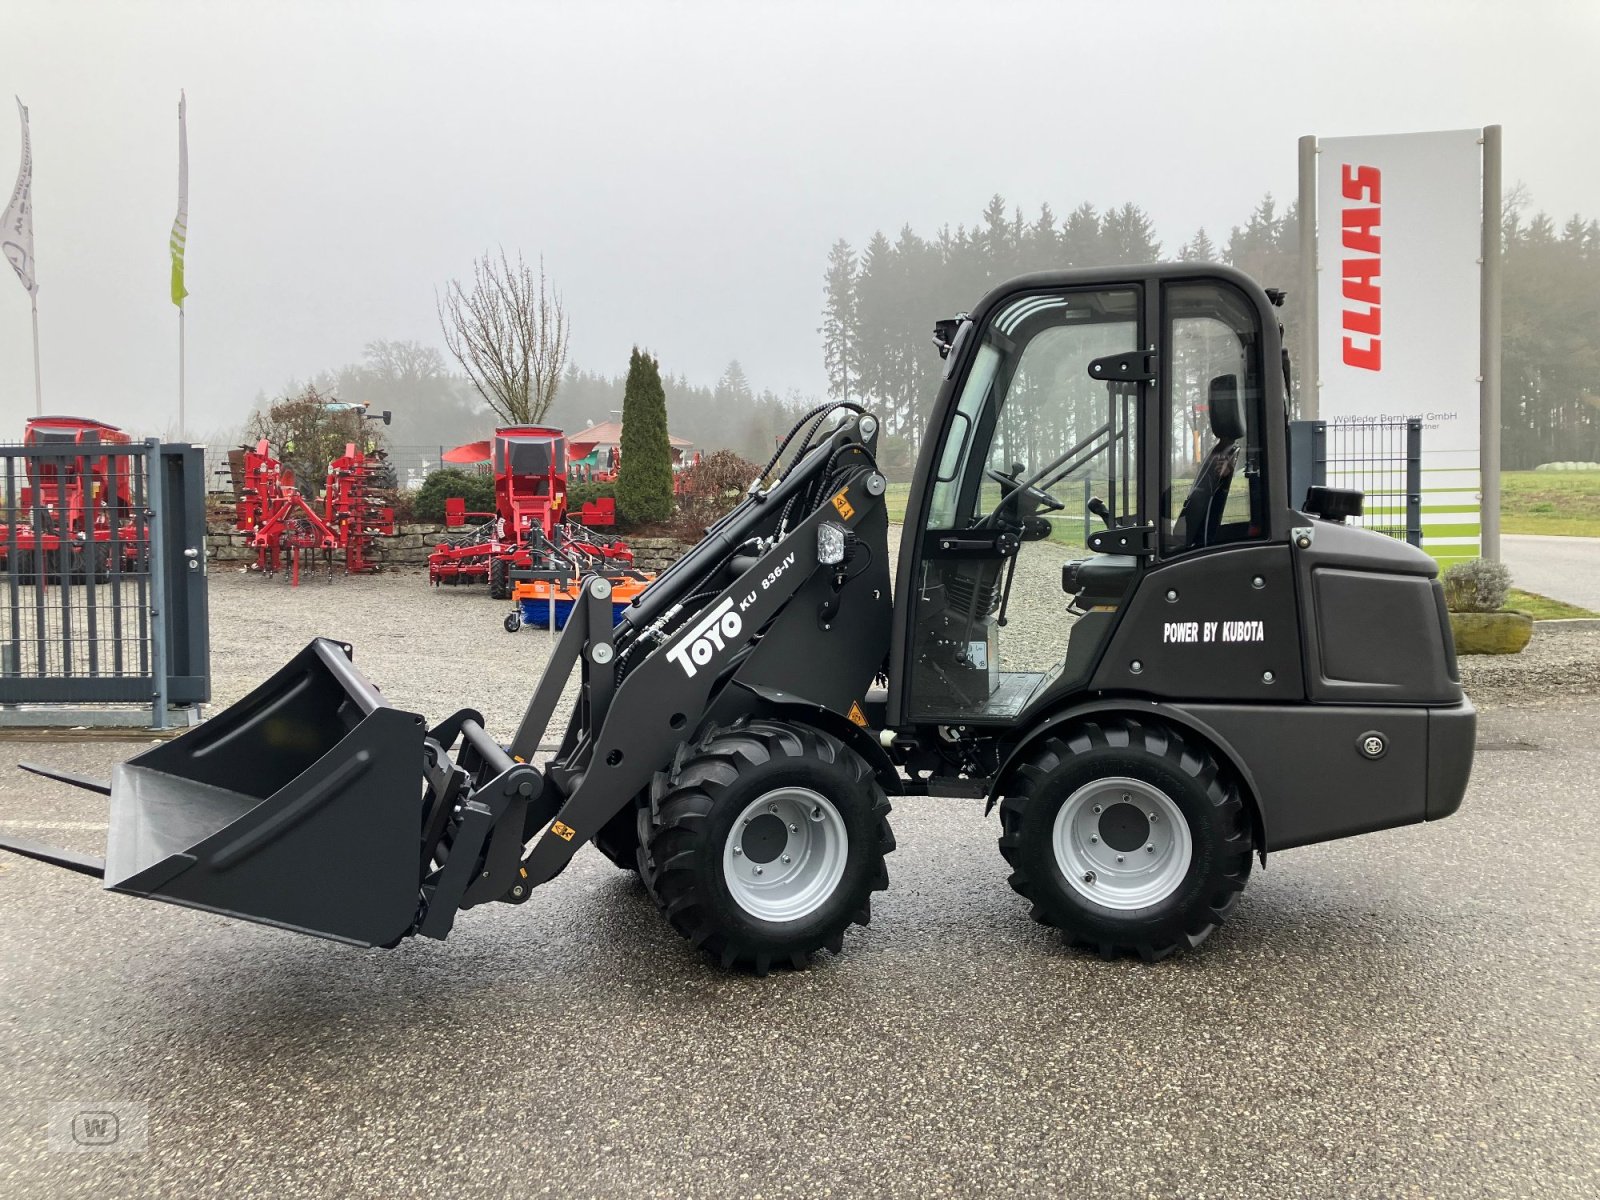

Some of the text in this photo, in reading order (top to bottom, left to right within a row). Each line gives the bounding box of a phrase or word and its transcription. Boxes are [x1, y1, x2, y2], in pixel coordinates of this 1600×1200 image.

[1342, 164, 1381, 372] CLAAS
[1426, 412, 1458, 421] GmbH
[740, 552, 795, 611] KU 836-IV
[666, 596, 742, 678] TOYO
[1164, 620, 1264, 643] POWER BY KUBOTA
